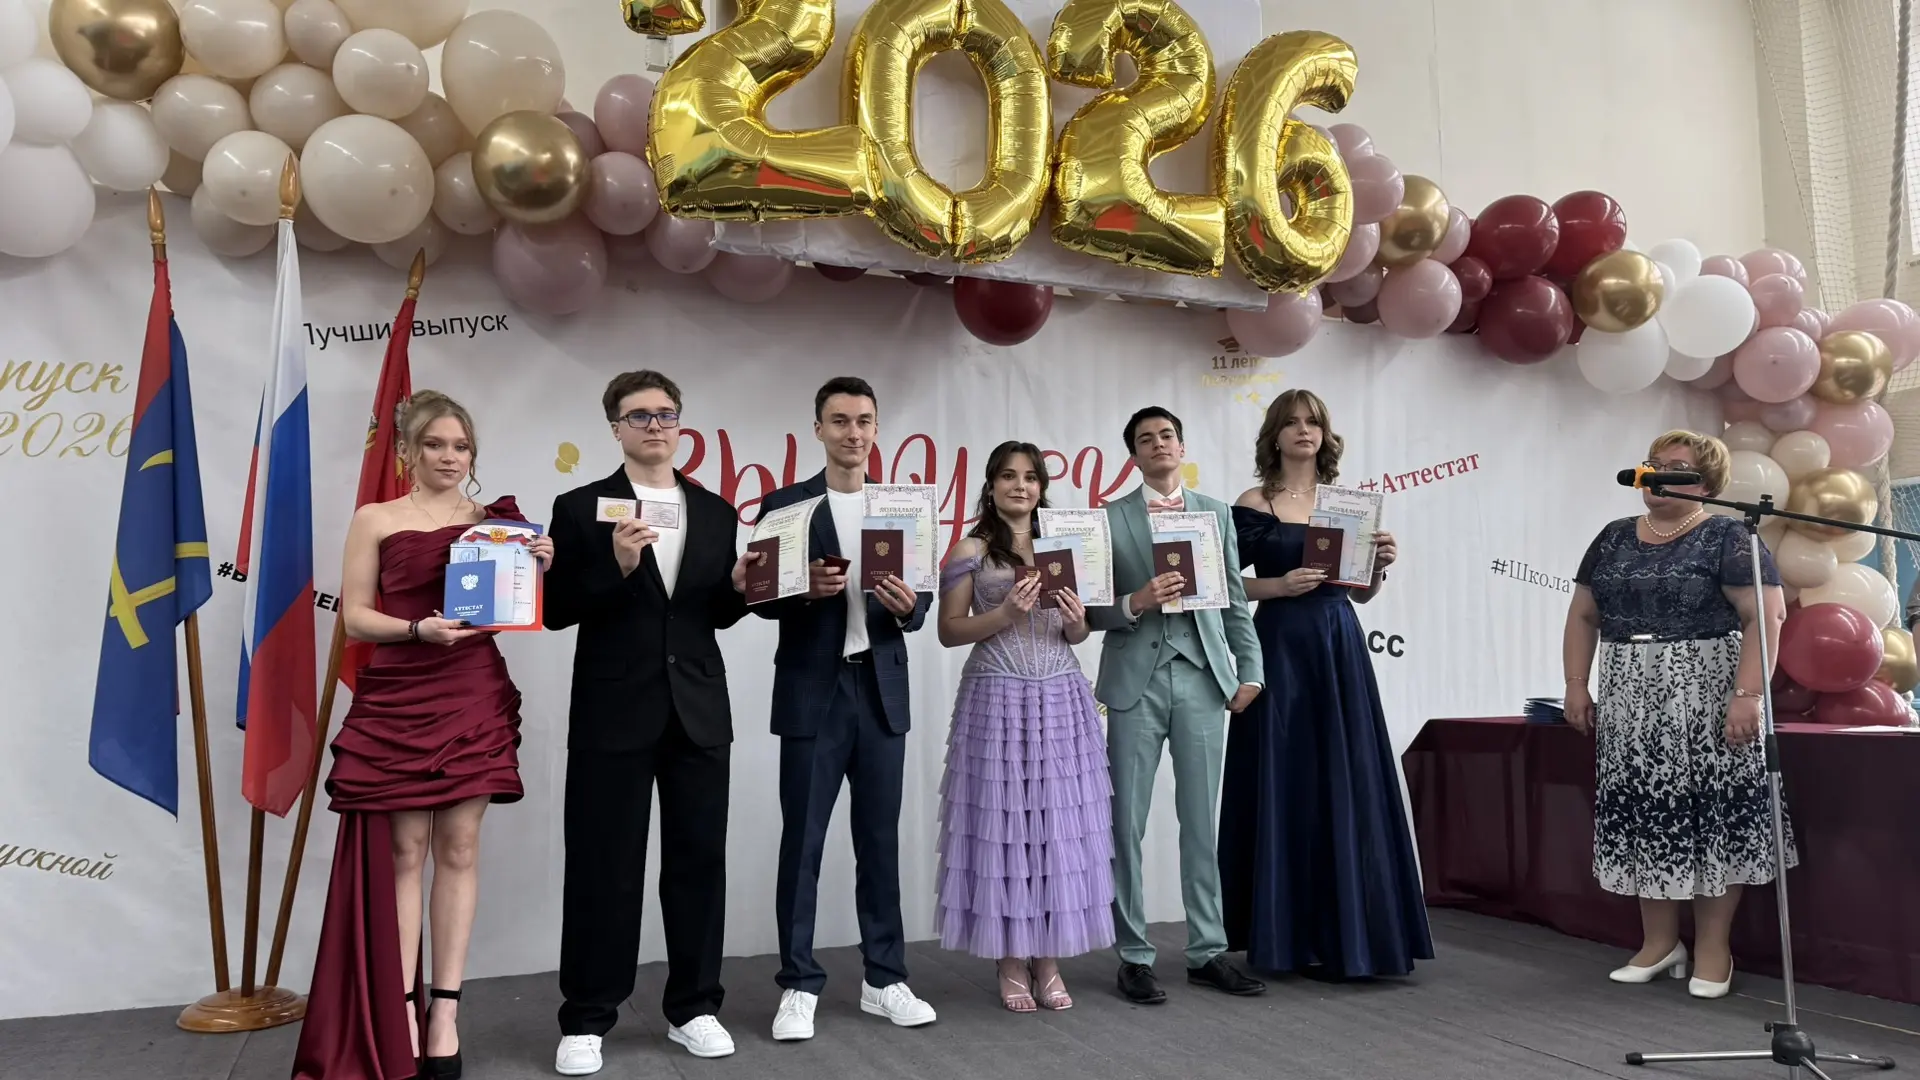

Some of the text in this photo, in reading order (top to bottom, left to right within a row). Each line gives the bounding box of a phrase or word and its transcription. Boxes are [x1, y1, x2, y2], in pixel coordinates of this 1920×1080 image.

[622, 0, 1359, 294] 2026
[412, 313, 509, 339] выпуск
[1211, 355, 1228, 370] 11
[1358, 453, 1480, 494] #Аттестат
[1490, 558, 1572, 594] #Школа
